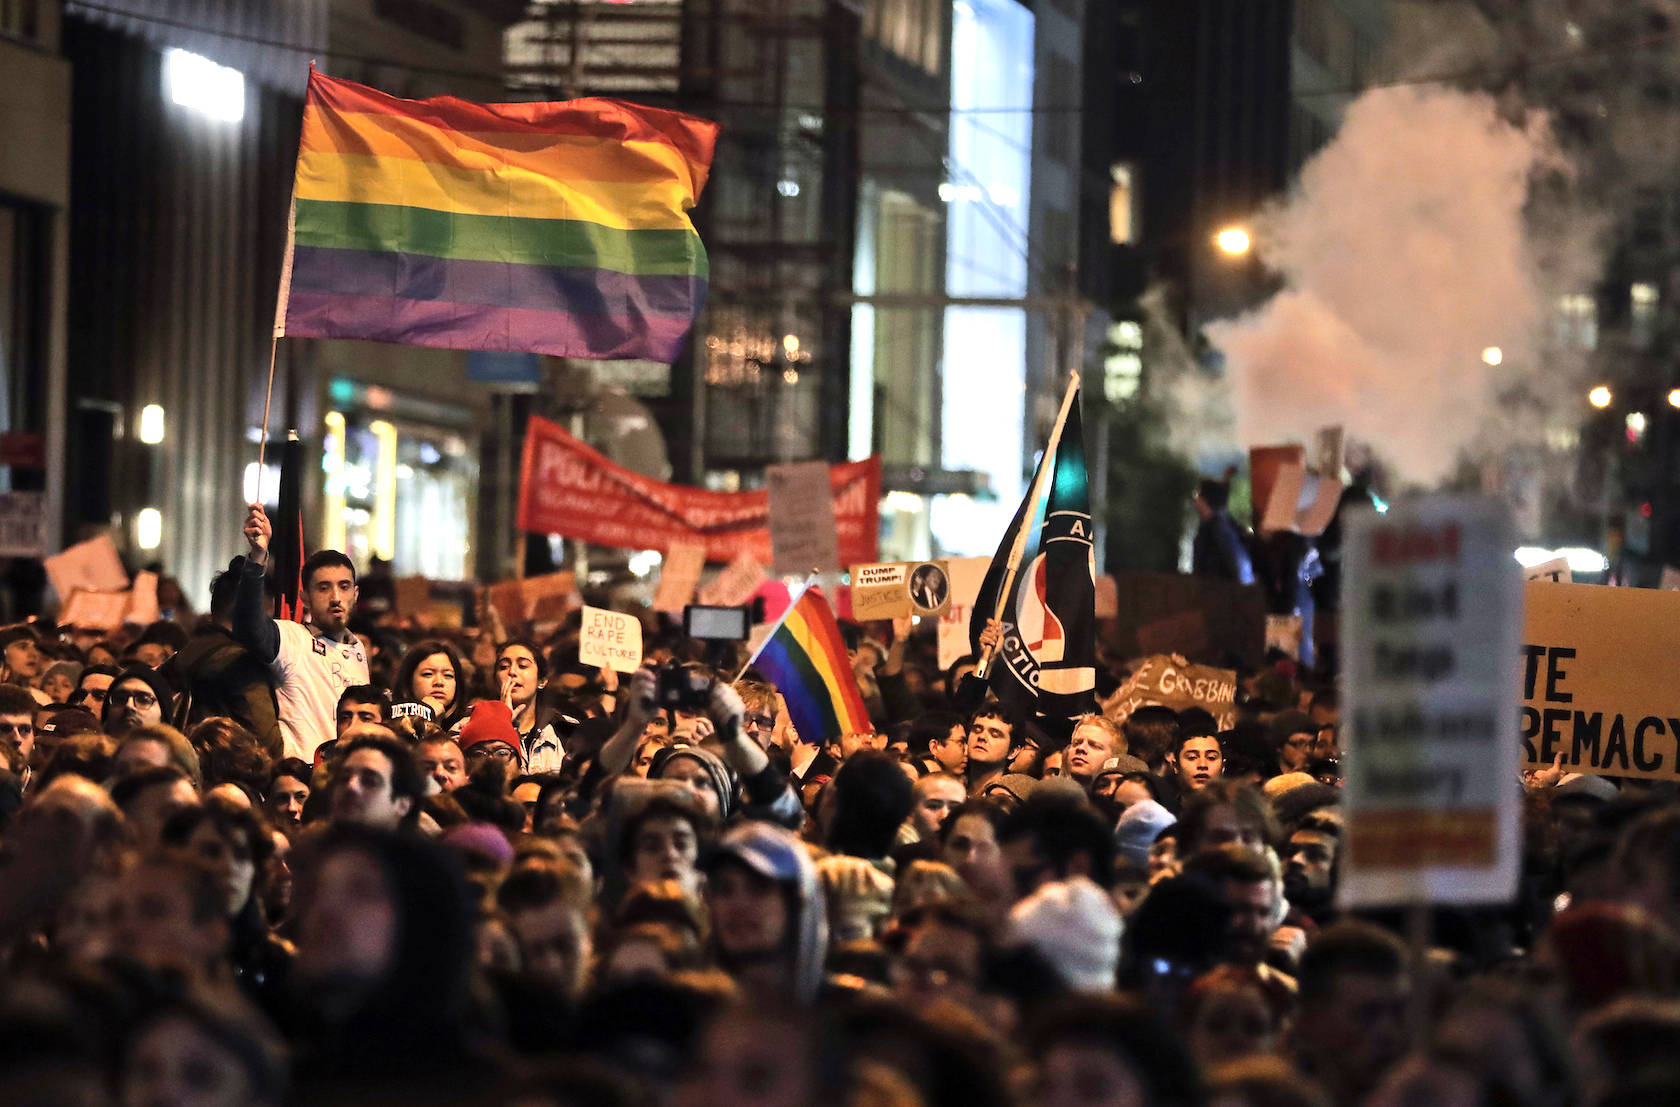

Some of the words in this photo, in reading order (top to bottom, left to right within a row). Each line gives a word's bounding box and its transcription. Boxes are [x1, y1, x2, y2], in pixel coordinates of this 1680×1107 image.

[1070, 519, 1093, 541] A
[859, 575, 902, 585] TRUMP!
[863, 567, 896, 576] DUMP
[861, 591, 903, 607] JUSTICE
[594, 613, 626, 631] END
[587, 626, 626, 644] RAPE
[585, 641, 637, 661] CULTURE
[391, 702, 432, 721] DETROIT
